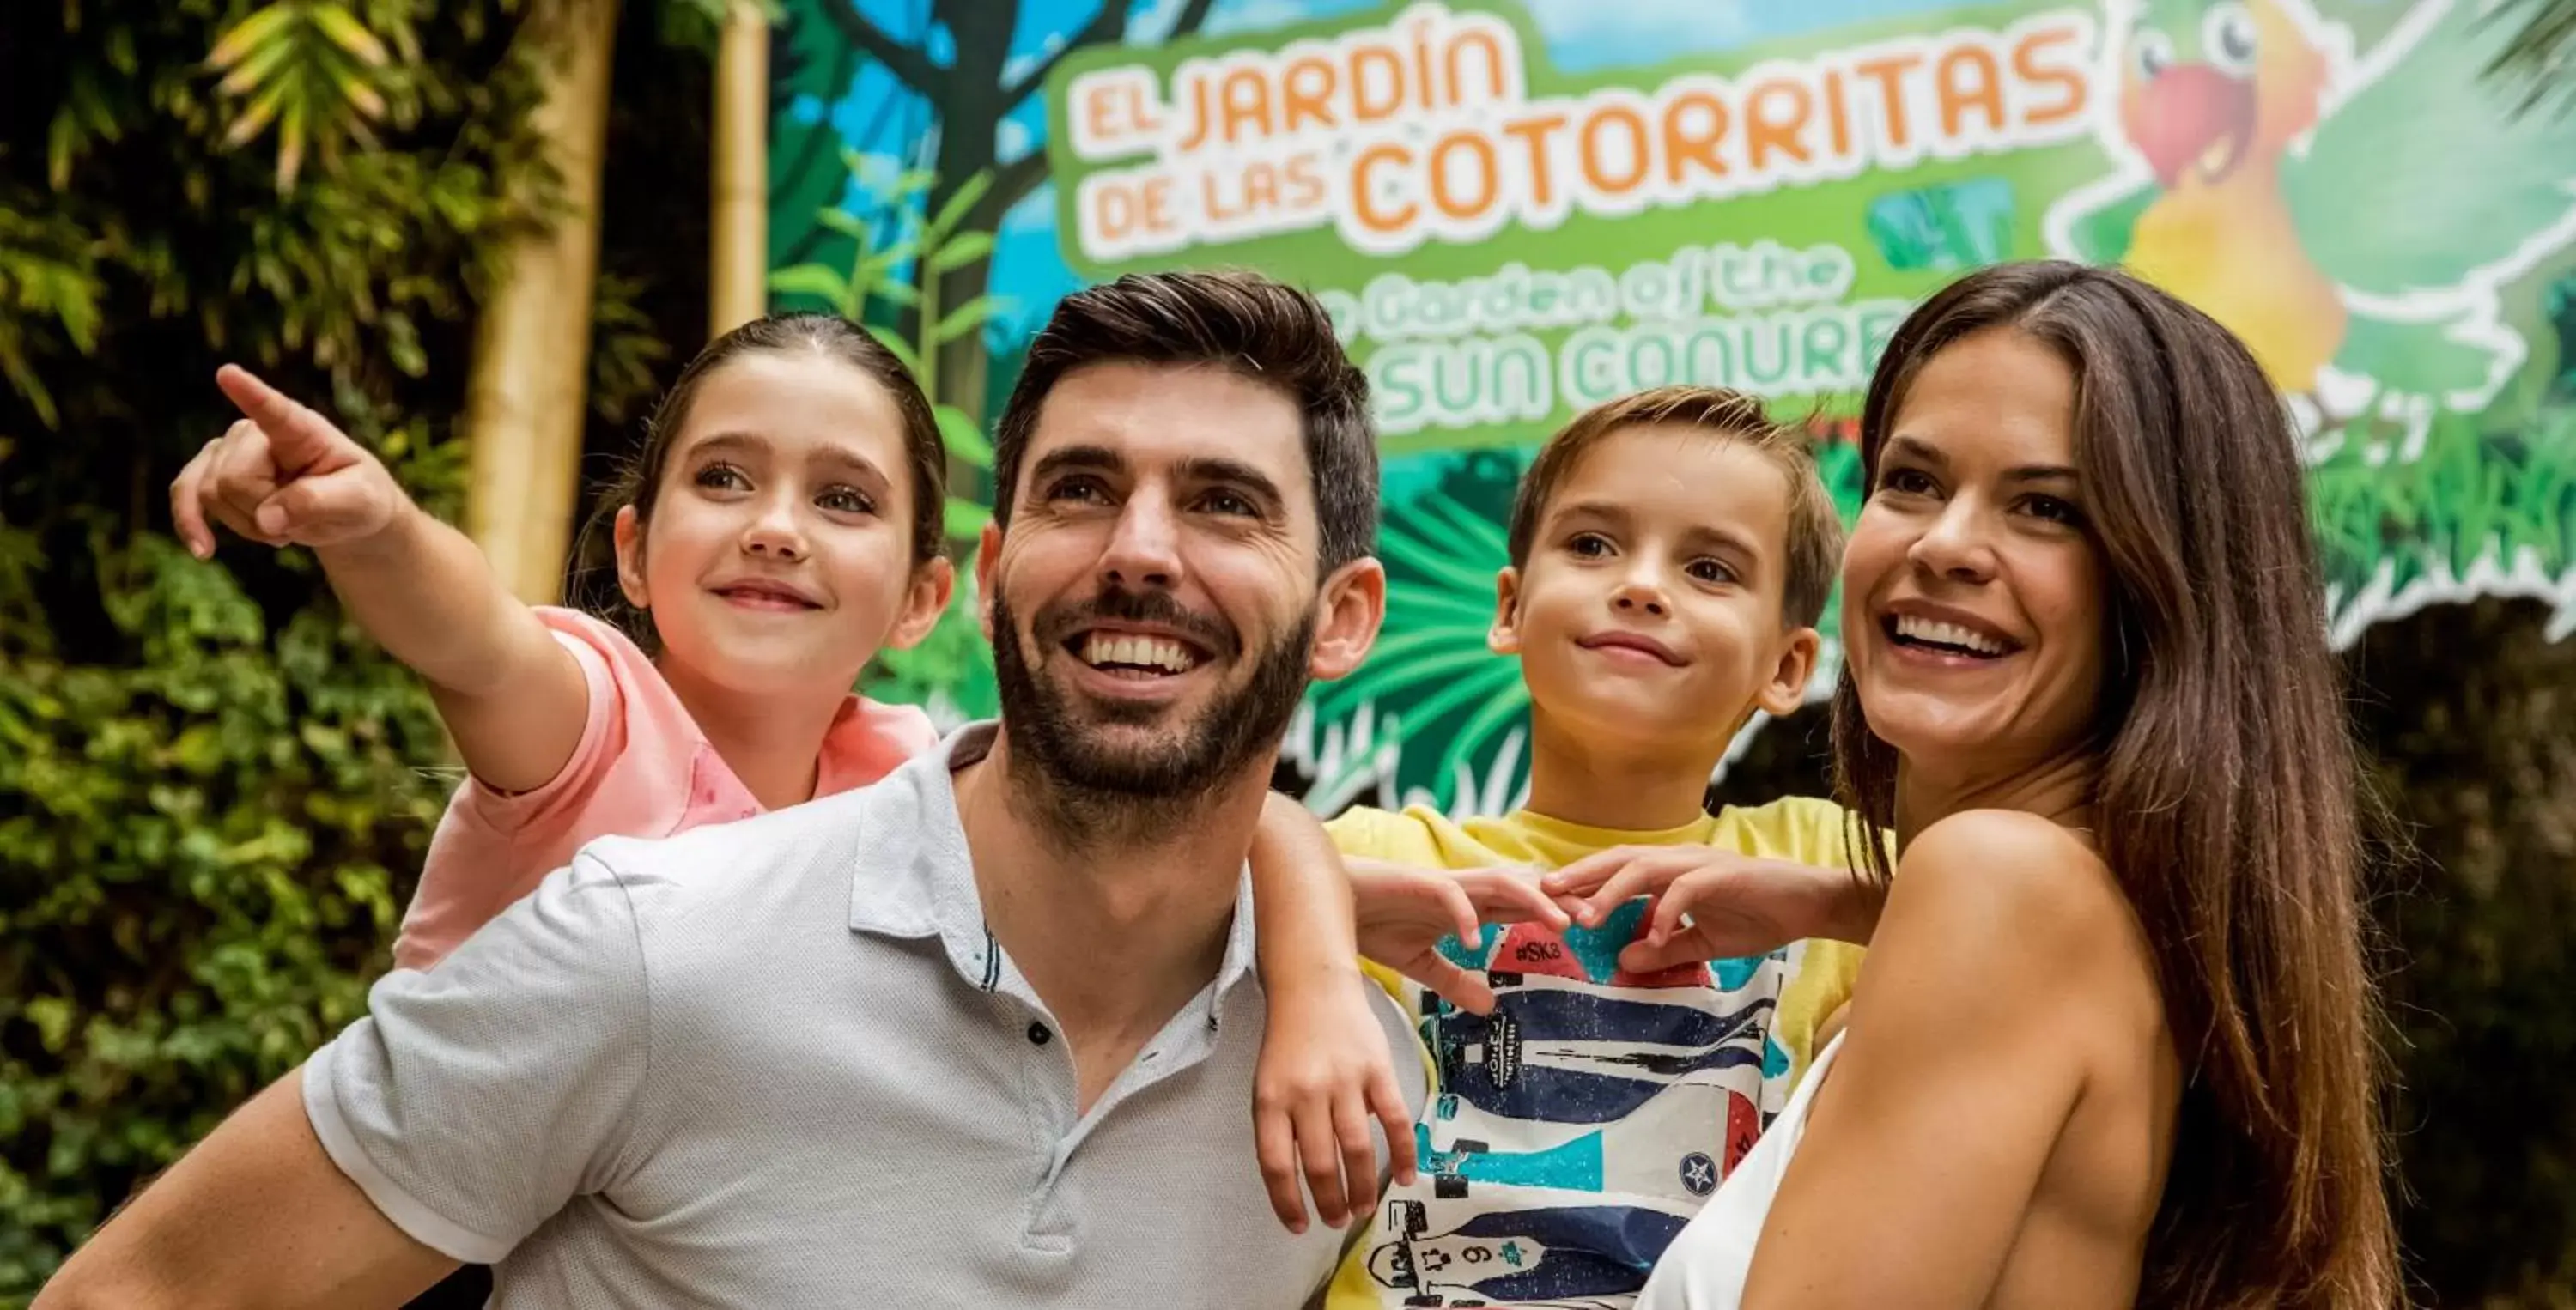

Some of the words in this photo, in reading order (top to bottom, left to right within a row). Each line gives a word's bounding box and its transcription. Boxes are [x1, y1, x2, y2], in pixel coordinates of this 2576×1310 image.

[1084, 82, 1163, 141] EL
[1177, 17, 1504, 153] JARDÍN
[1097, 177, 1175, 241] DE
[1202, 155, 1327, 221] LAS
[1350, 28, 2087, 233] COTORRITAS
[1374, 275, 1608, 327] Garden
[1632, 254, 1700, 303] of
[1721, 250, 1843, 295] the
[1379, 345, 1537, 418] SUN
[1516, 941, 1562, 962] #SK8
